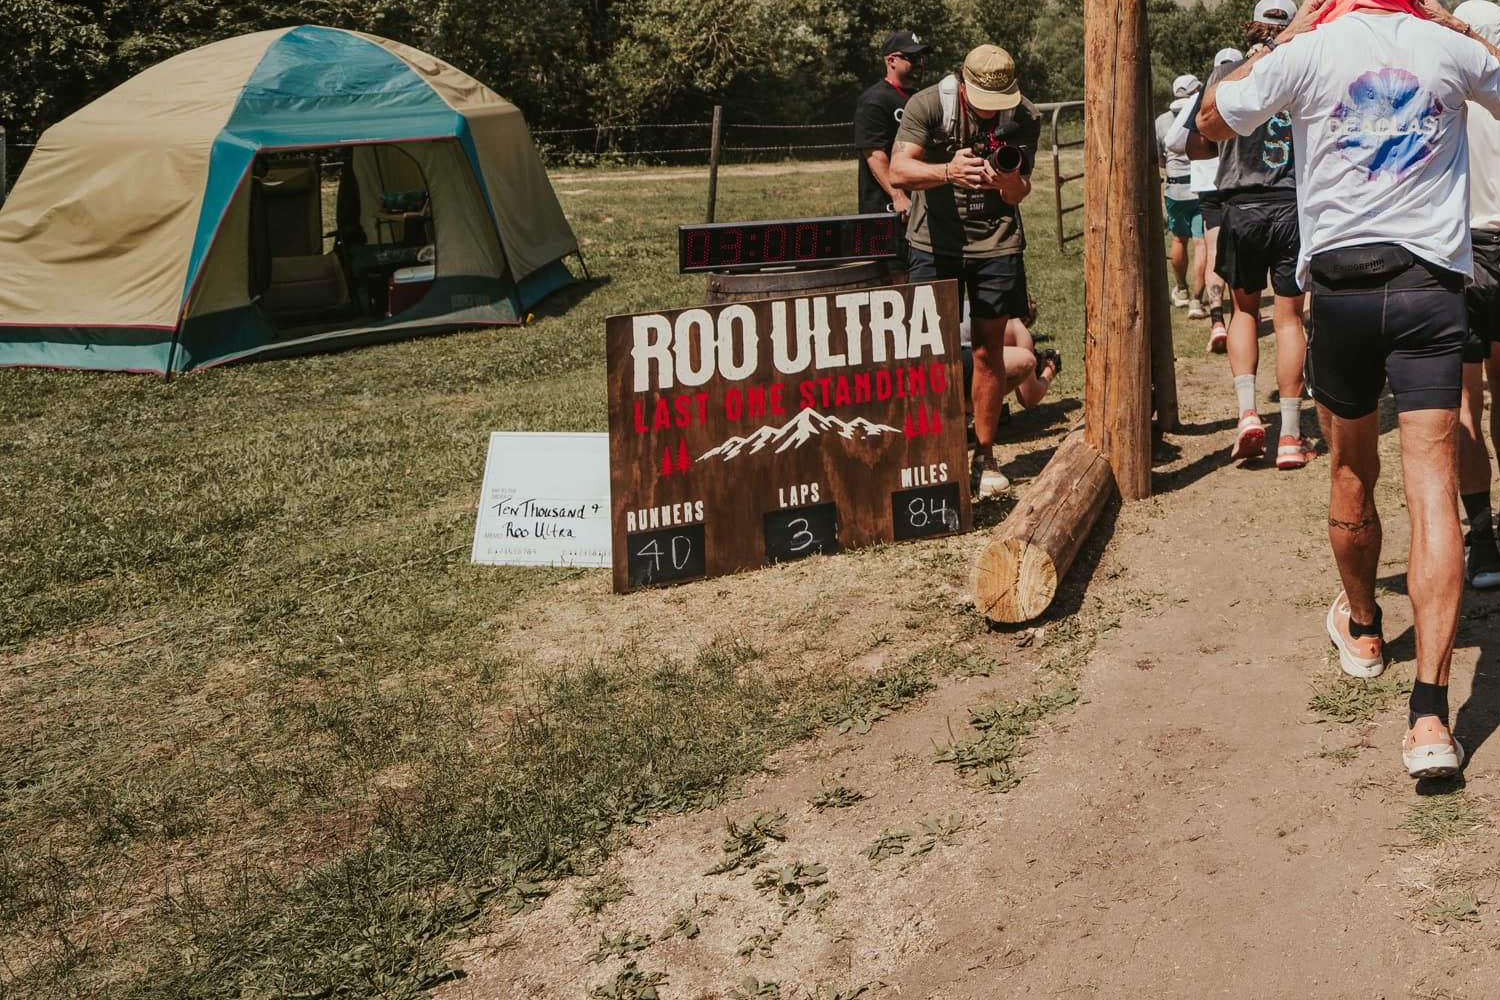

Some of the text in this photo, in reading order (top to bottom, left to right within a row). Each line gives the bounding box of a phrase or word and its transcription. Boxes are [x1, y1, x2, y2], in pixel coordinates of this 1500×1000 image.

[686, 218, 894, 268] 03:00:12
[631, 284, 945, 393] ROO ULTRA
[633, 362, 947, 434] LAST ONE STANDING
[900, 462, 949, 489] MILES
[778, 482, 821, 509] LAPS
[626, 500, 705, 533] RUNNERS
[786, 517, 815, 552] 3
[635, 535, 692, 572] 40
